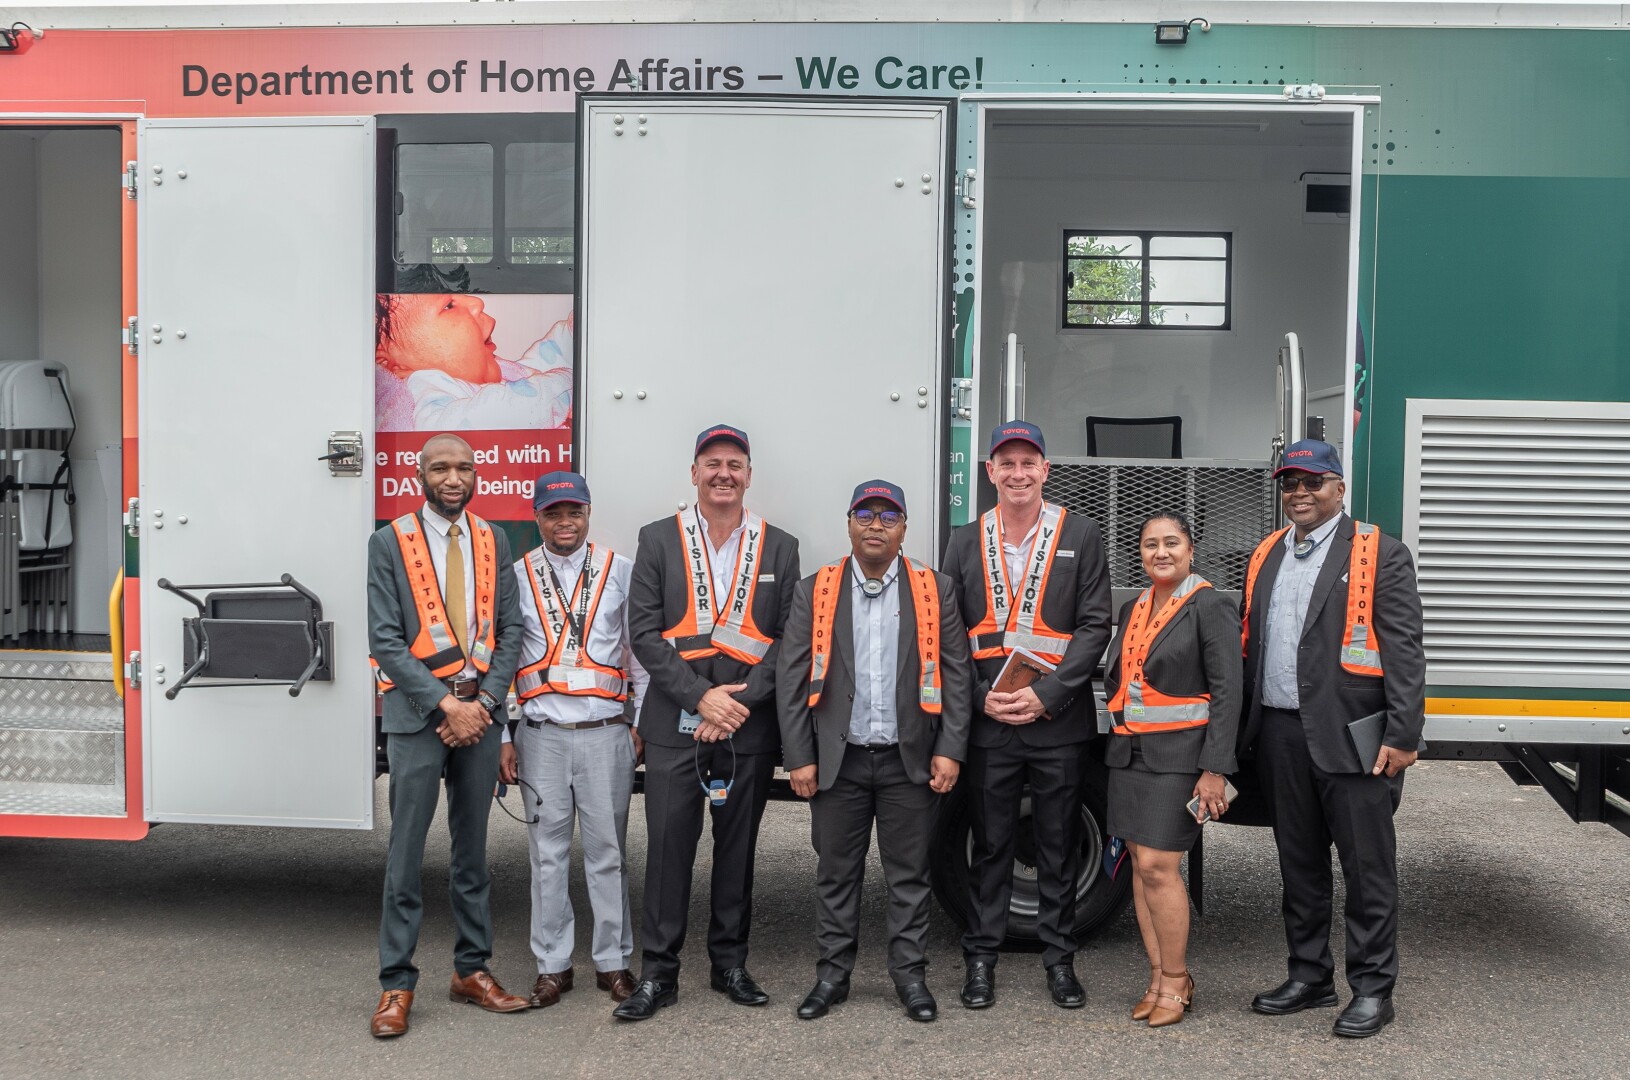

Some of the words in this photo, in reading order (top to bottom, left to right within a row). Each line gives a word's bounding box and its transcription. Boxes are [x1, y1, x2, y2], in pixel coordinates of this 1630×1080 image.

[182, 62, 414, 105] Department
[426, 60, 468, 94] of
[480, 60, 596, 93] Home
[607, 57, 745, 92] Affairs
[795, 56, 860, 90] We
[874, 56, 984, 91] Care!
[506, 444, 550, 463] with
[1002, 428, 1031, 436] TOYOTA
[1287, 450, 1314, 459] TOYOTA
[476, 475, 535, 500] being
[546, 482, 575, 491] TOYOTA
[863, 487, 892, 495] TOYOTA
[406, 533, 439, 624] VISITOR
[480, 529, 491, 618] VISITOR
[686, 524, 709, 611] VISITOR
[733, 529, 759, 614] VISITOR
[986, 524, 1005, 609] VISITOR
[1021, 526, 1054, 614] VISITOR
[1357, 534, 1370, 625] VISITOR
[817, 566, 836, 653] VISITOR
[918, 571, 934, 660] VISITOR
[1133, 598, 1179, 681] VISITOR
